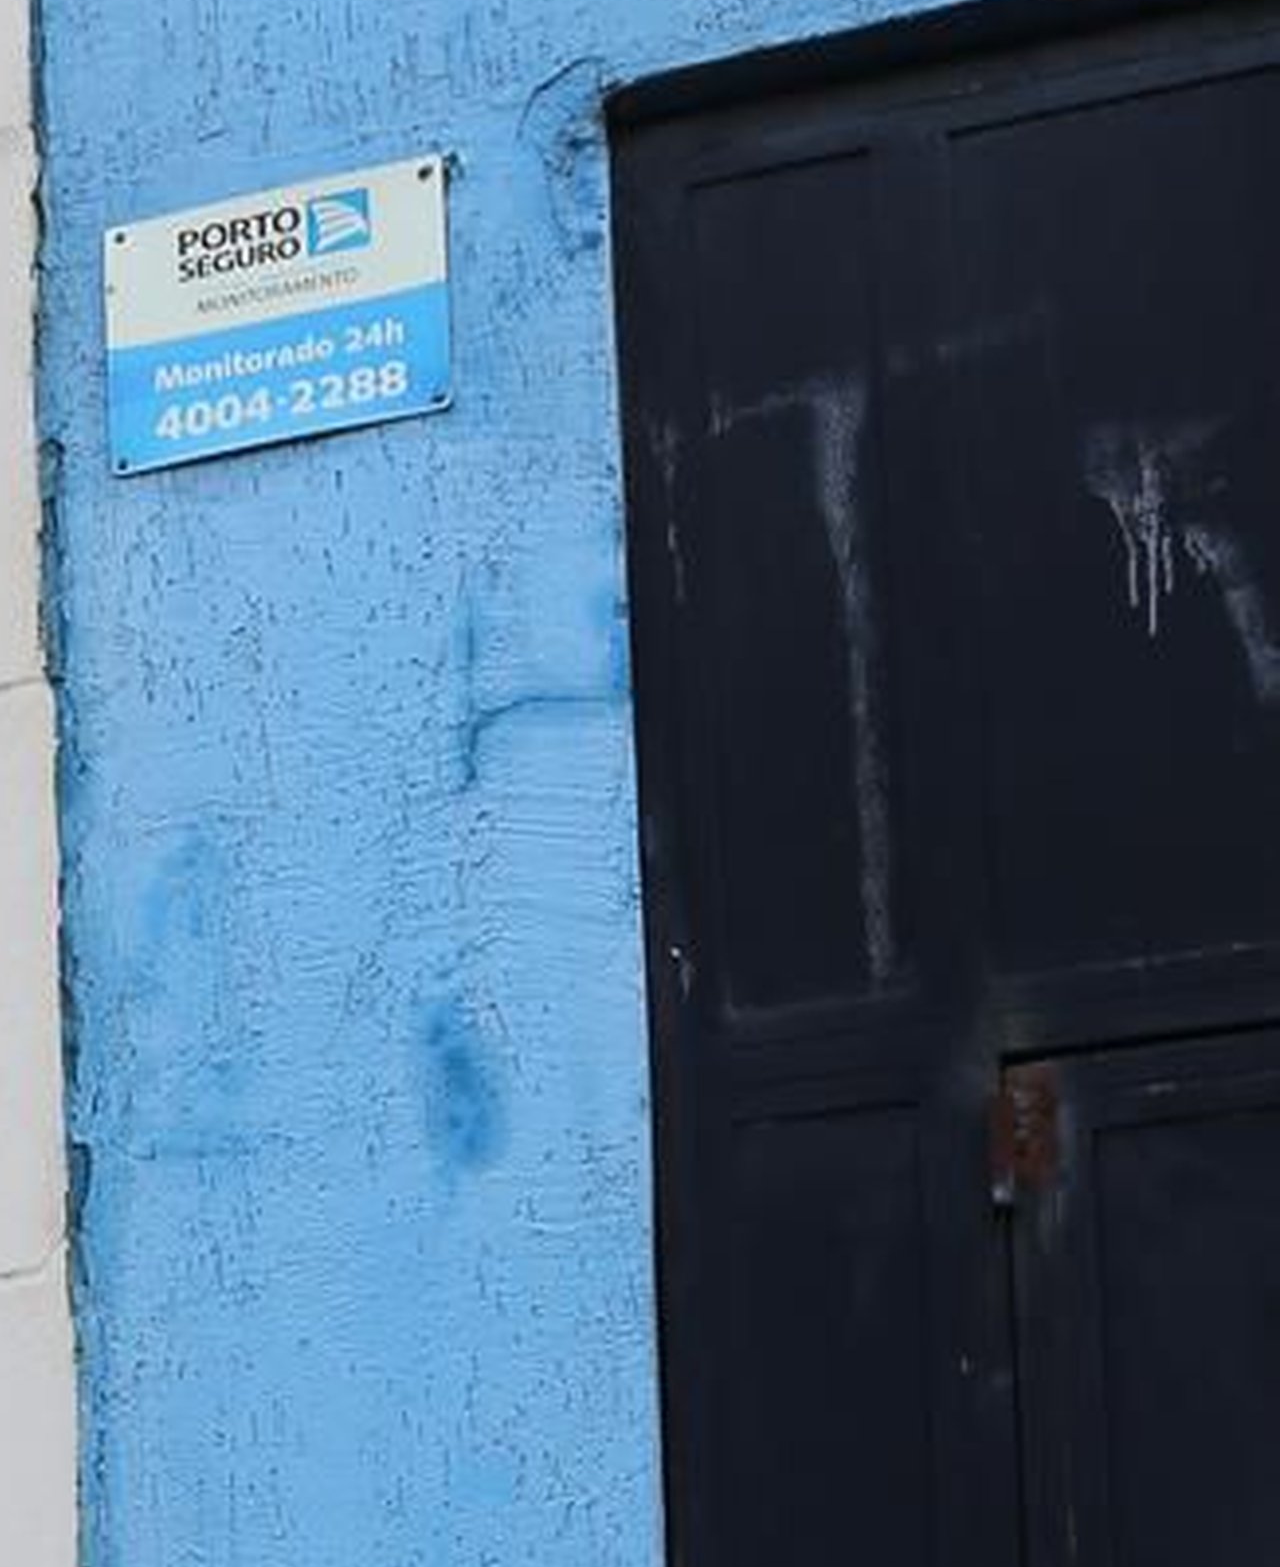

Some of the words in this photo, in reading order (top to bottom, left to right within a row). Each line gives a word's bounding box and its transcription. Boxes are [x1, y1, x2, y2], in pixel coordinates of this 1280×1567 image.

[177, 206, 301, 256] PORTO
[177, 236, 301, 283] SEGURO
[154, 337, 334, 390] Monitorado
[345, 317, 404, 354] 24h
